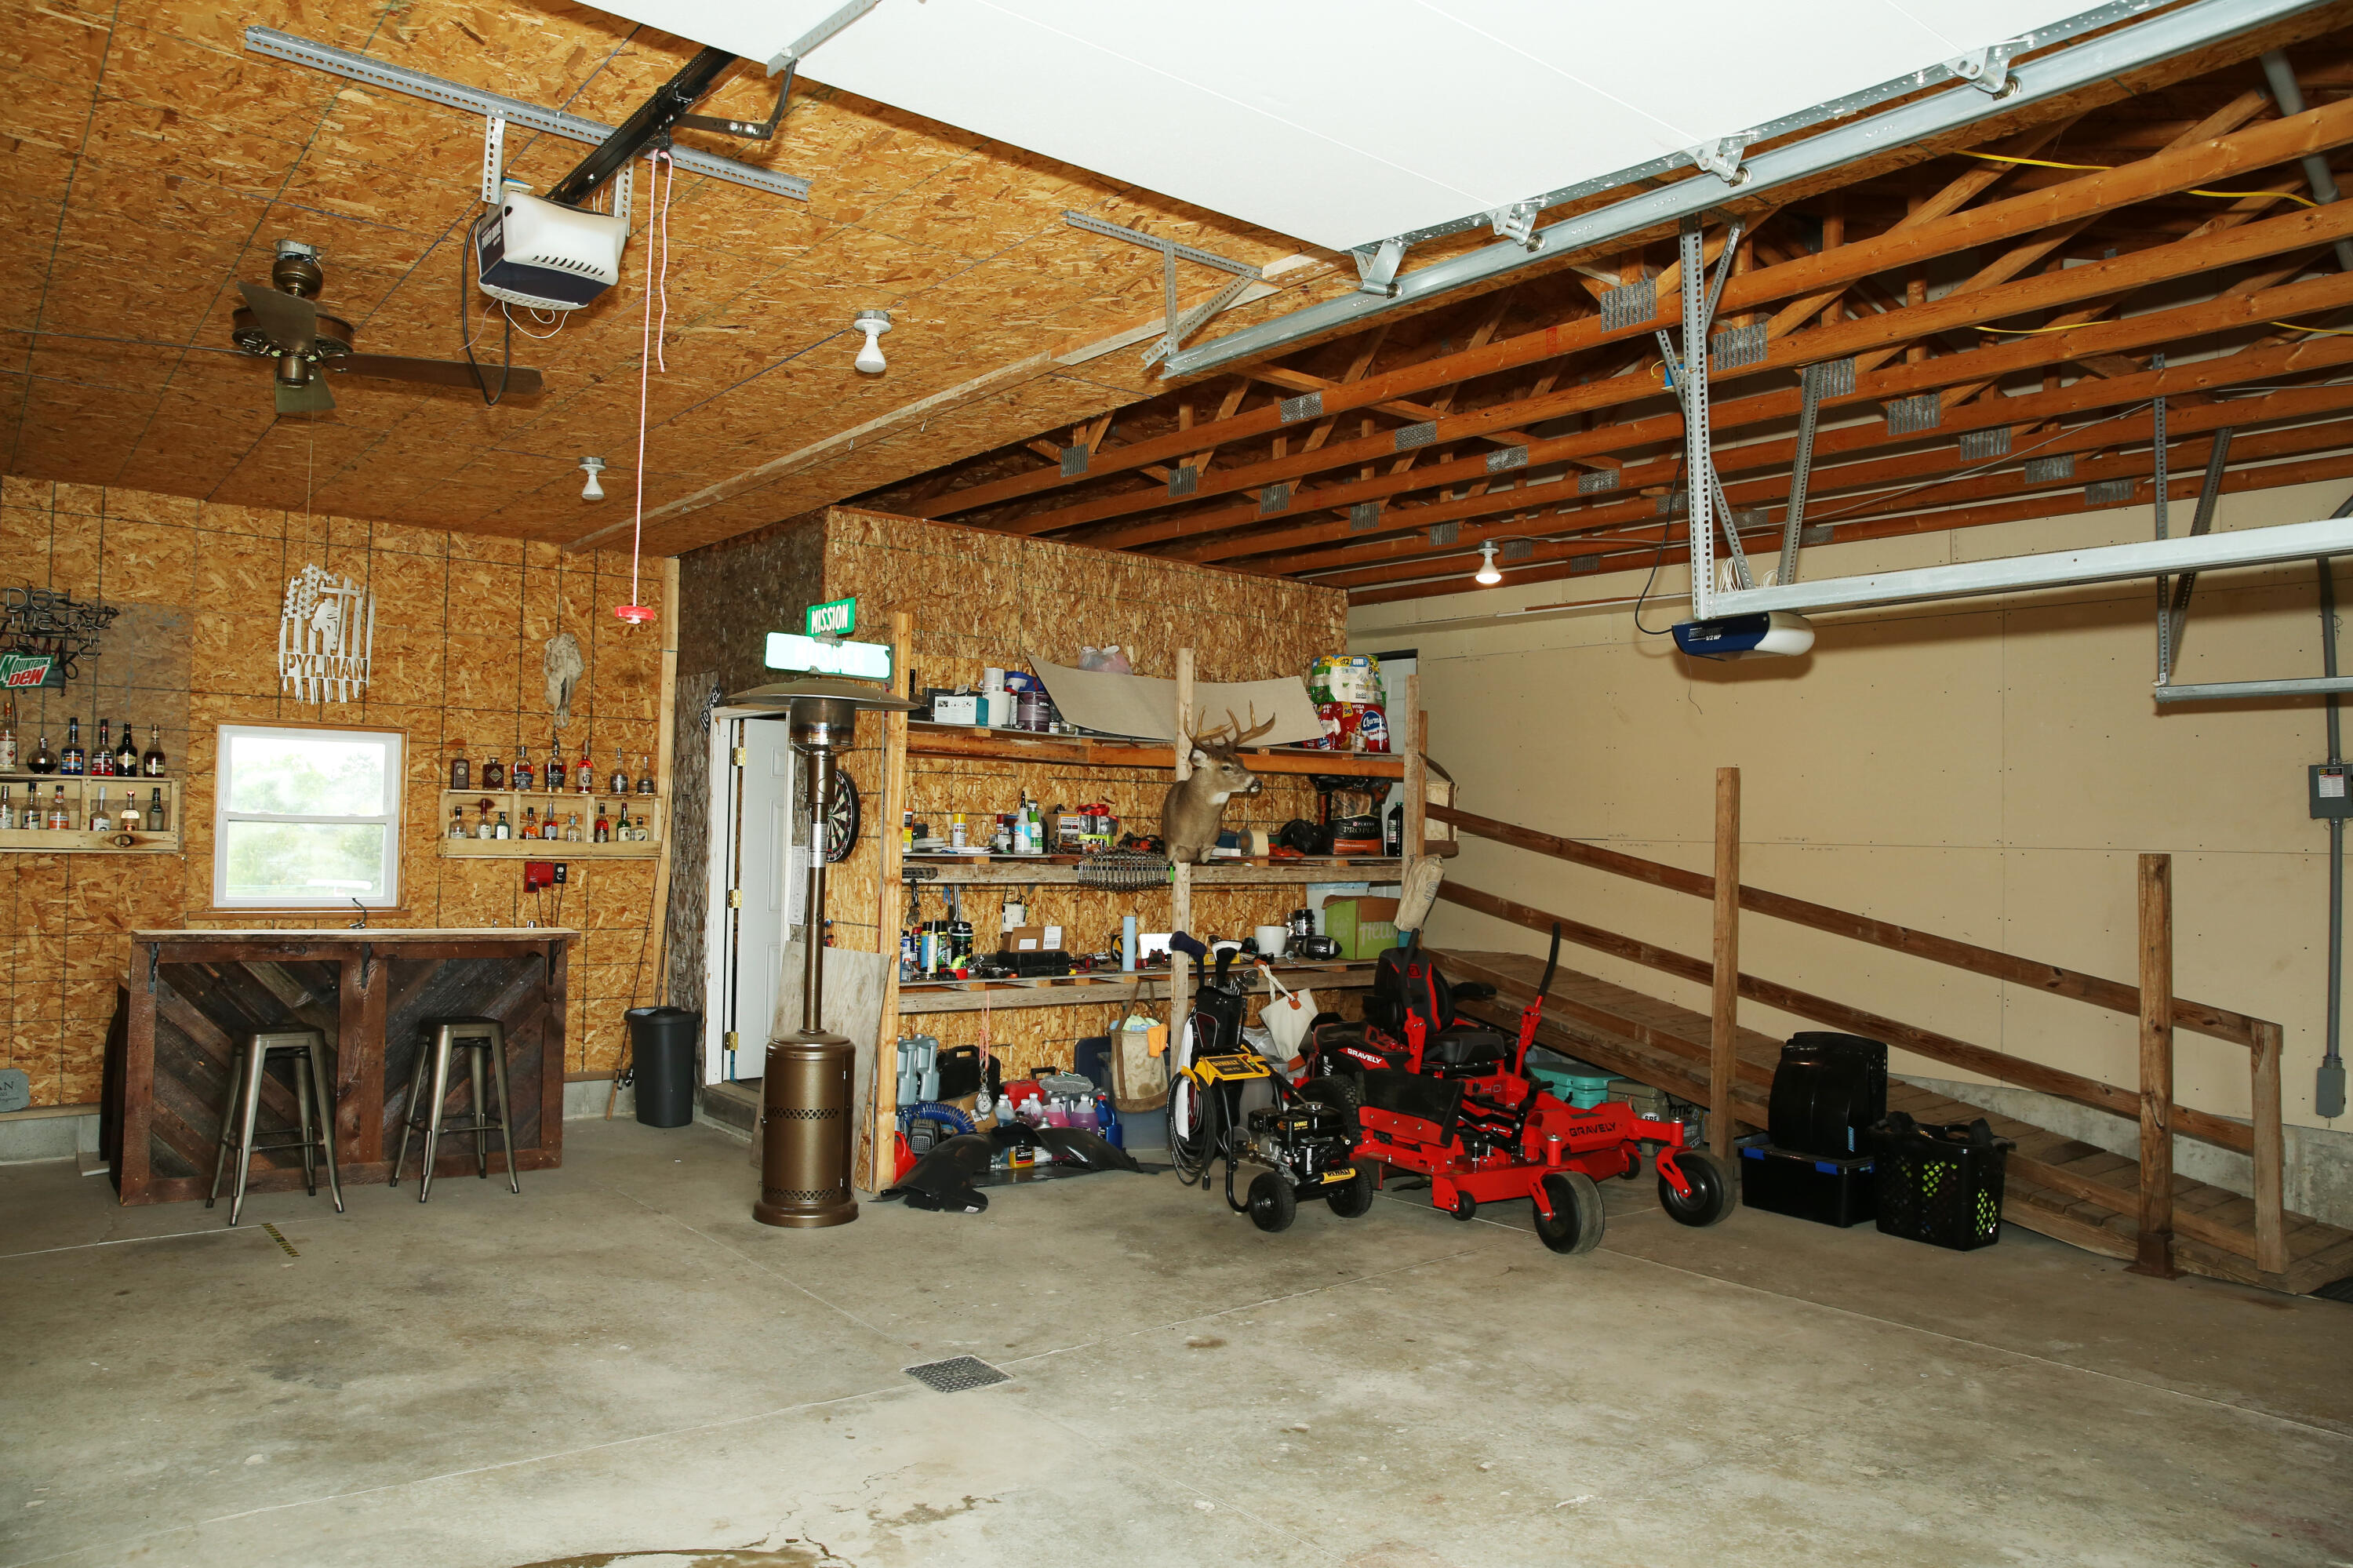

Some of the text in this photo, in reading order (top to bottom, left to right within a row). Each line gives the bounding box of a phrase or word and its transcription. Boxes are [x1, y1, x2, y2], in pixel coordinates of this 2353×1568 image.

[811, 603, 849, 635] MISSION
[282, 652, 368, 682] PYLMAN
[1362, 715, 1385, 728] Charm
[1347, 1047, 1382, 1064] GRAVELY
[1569, 1122, 1617, 1137] GRAVELY
